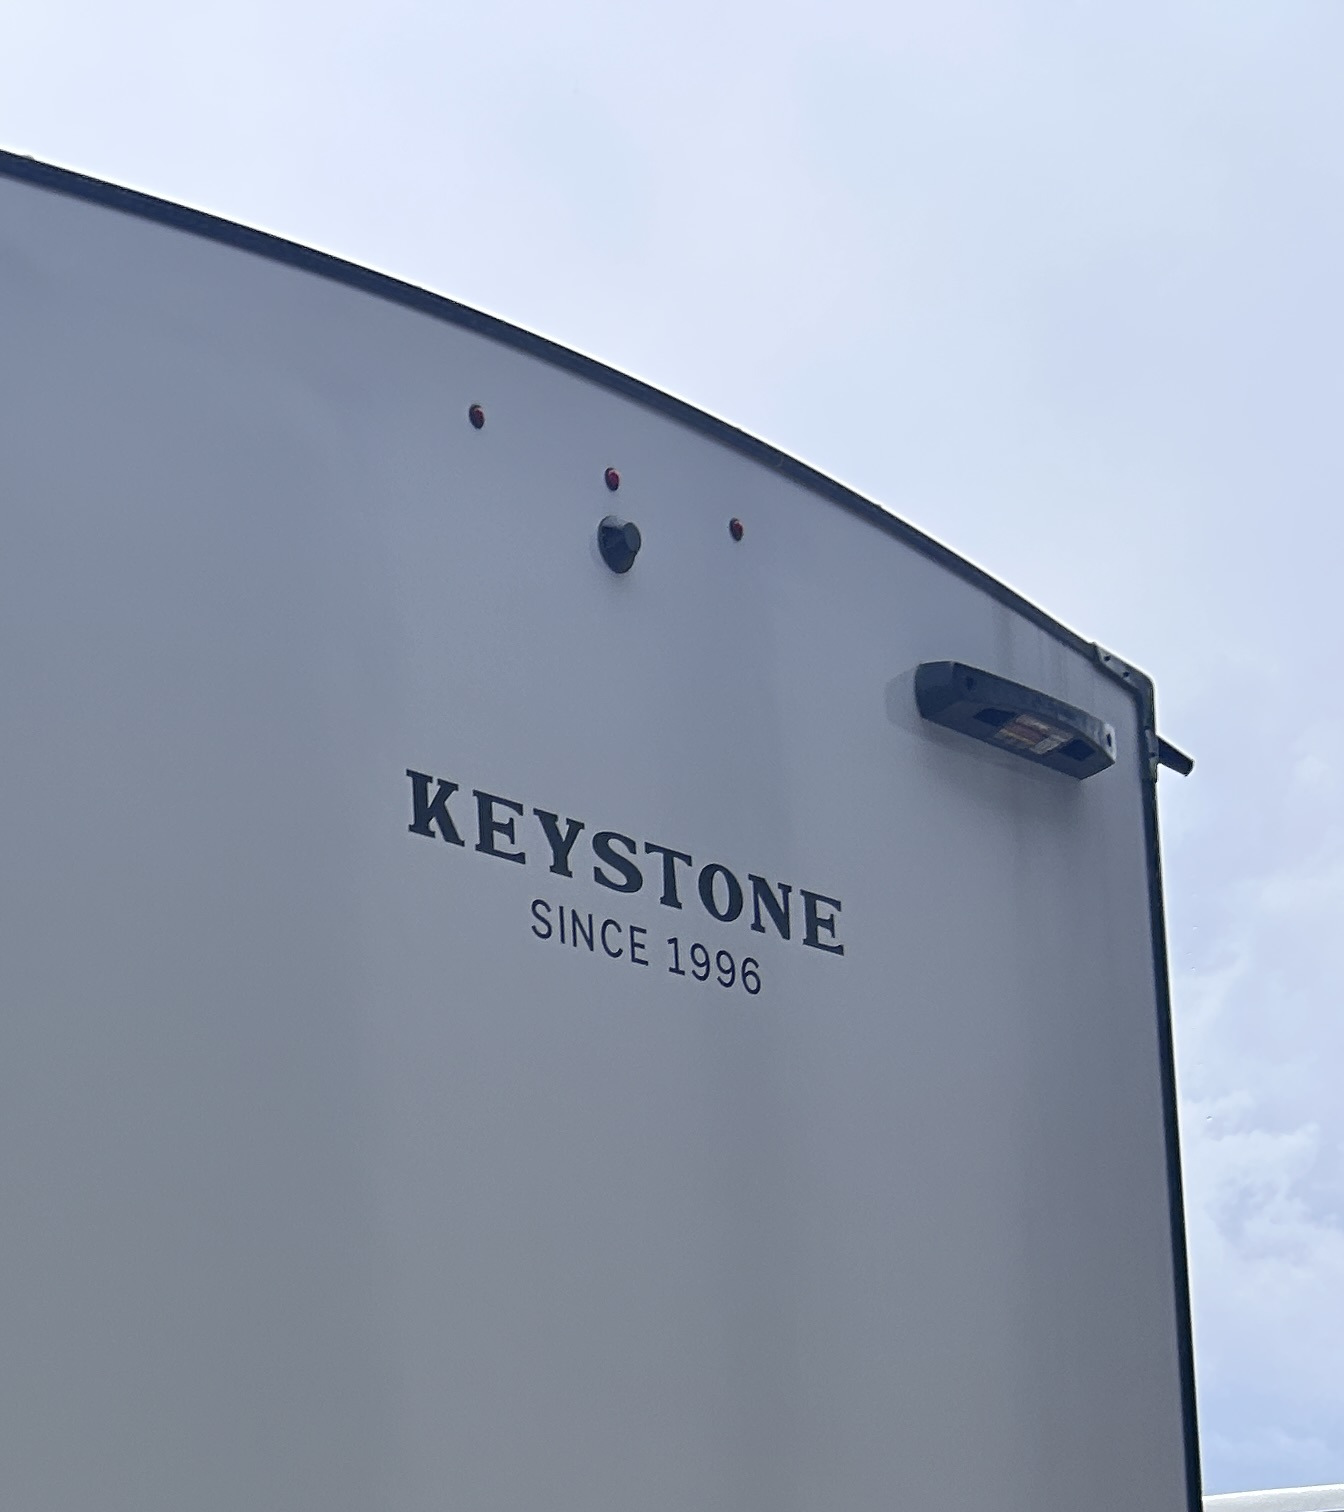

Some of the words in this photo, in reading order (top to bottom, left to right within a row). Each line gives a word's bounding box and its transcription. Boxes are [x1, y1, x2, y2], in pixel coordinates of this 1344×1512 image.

[406, 768, 845, 956] KEYSTONE
[530, 899, 649, 967] SINCE
[666, 936, 762, 996] 1996
